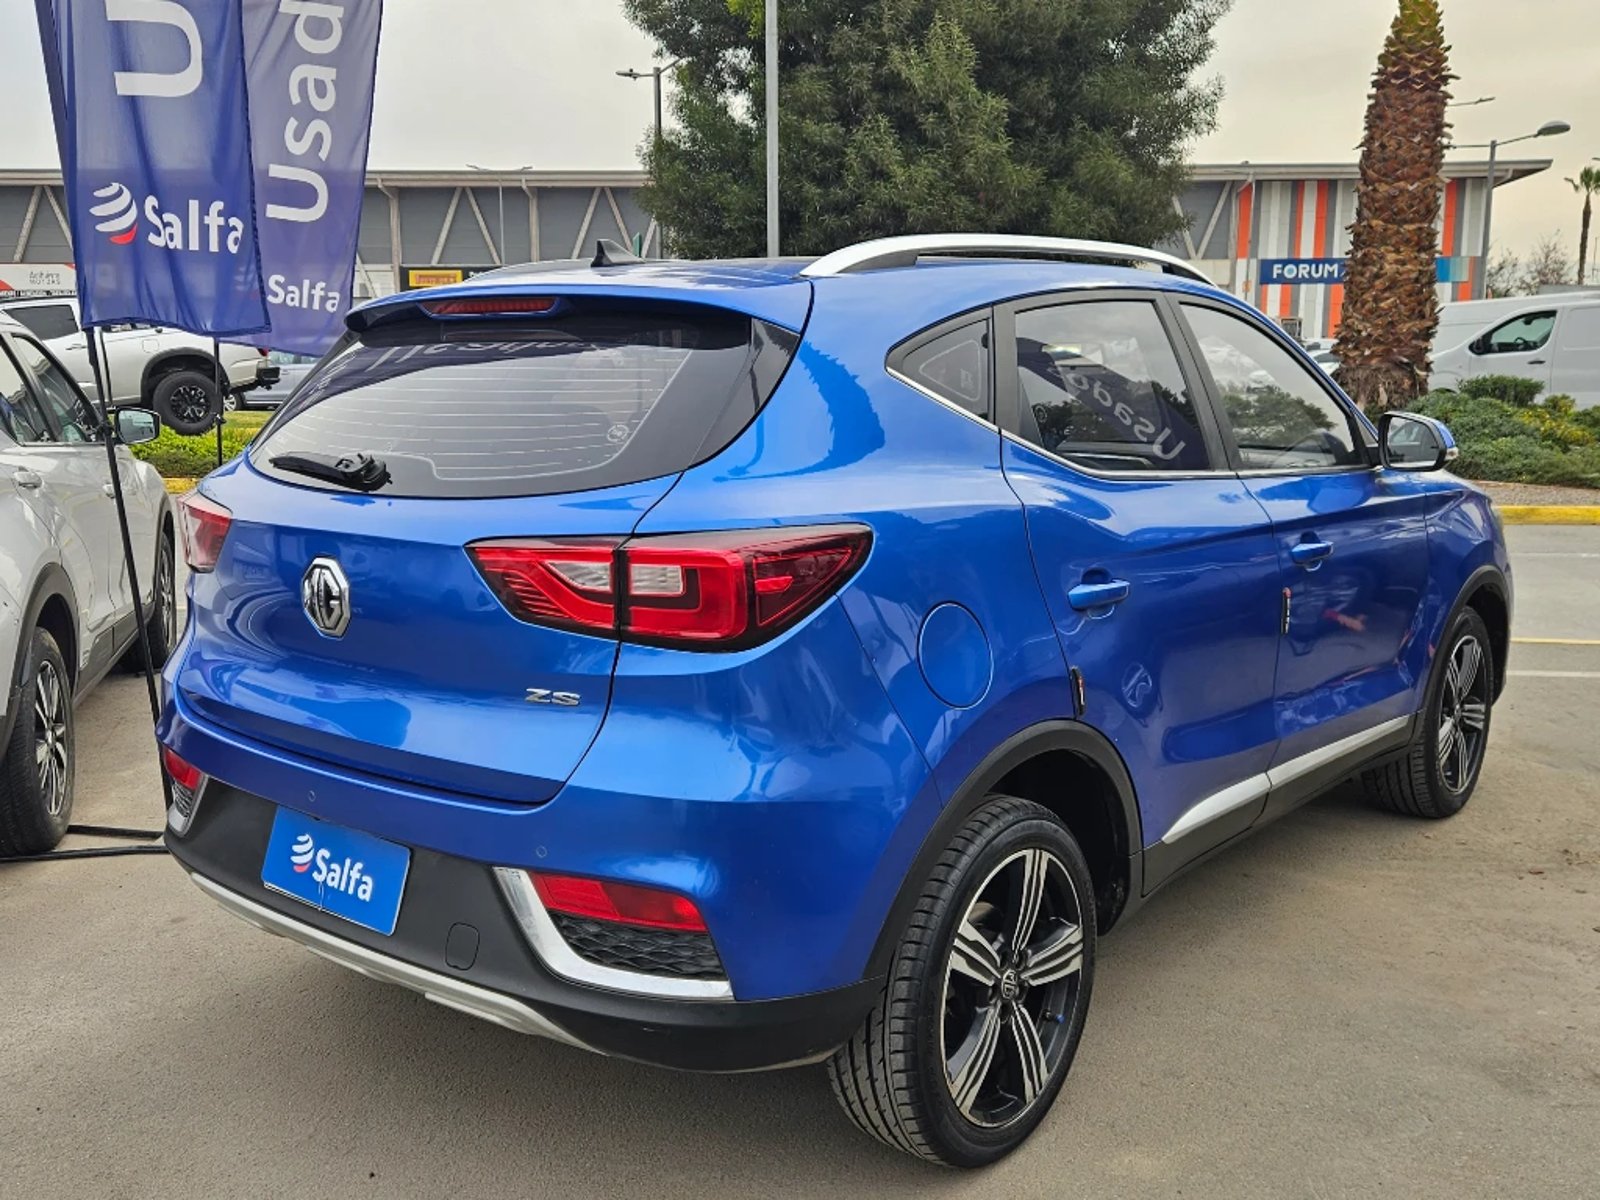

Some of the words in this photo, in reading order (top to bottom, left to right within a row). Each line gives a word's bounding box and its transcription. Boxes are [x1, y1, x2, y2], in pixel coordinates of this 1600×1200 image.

[144, 194, 244, 254] Salfa
[266, 274, 341, 313] Salfa
[1272, 263, 1339, 279] FORUM
[303, 563, 345, 633] MG
[525, 688, 582, 705] ZS
[312, 847, 374, 903] Salfa
